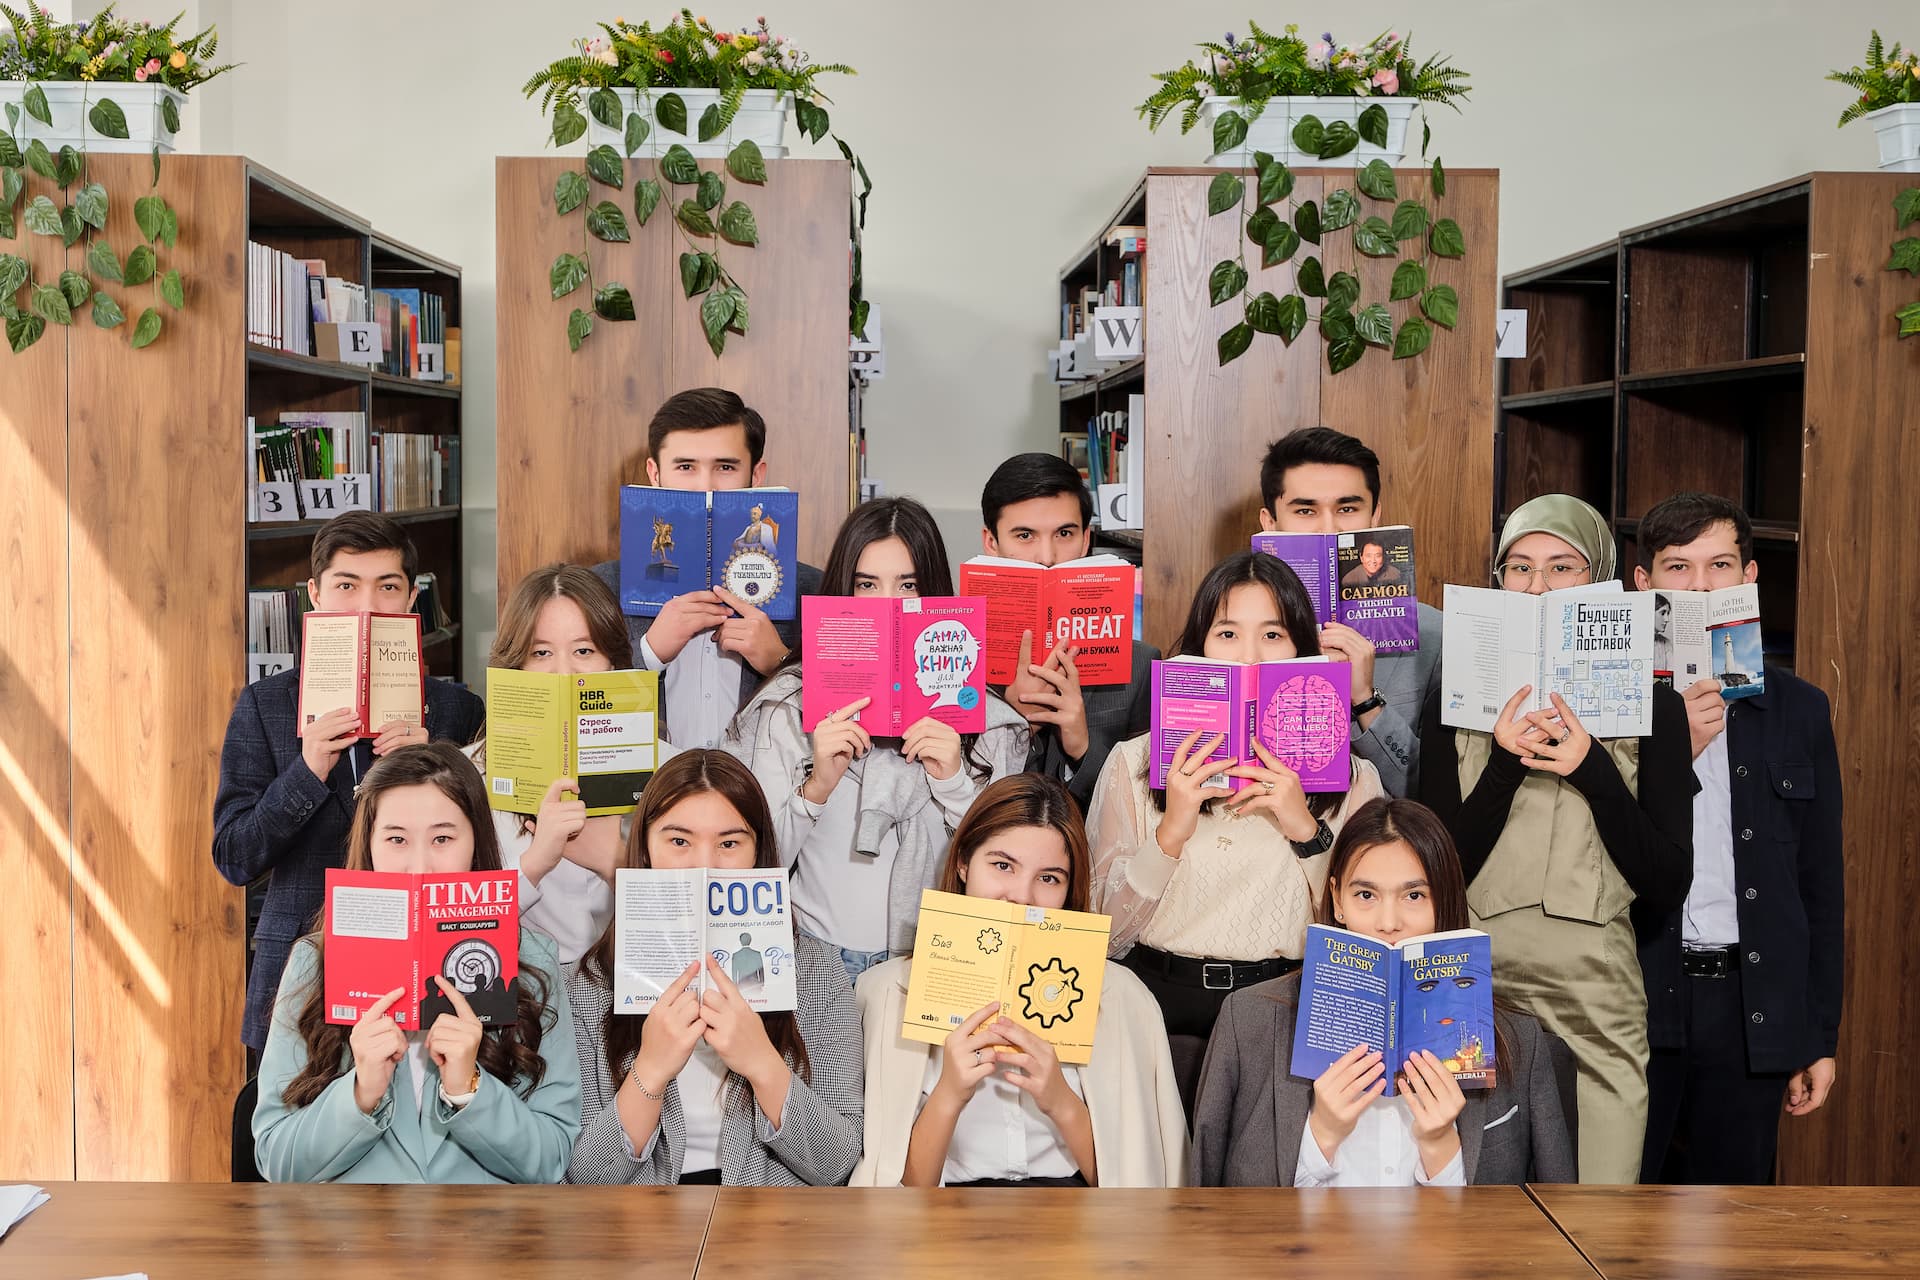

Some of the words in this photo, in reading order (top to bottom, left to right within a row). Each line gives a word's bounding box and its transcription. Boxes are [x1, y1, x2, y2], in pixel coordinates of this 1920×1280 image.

[350, 329, 371, 352] Е
[1098, 318, 1141, 349] W
[310, 487, 336, 509] И
[343, 476, 360, 505] Й
[263, 490, 282, 513] З
[1341, 584, 1409, 600] САРМОЯ
[1357, 599, 1393, 607] ТИКИШ
[1721, 599, 1730, 607] TO
[1732, 597, 1745, 606] THE
[1070, 607, 1097, 615] GOOD
[1099, 606, 1112, 614] TO
[1346, 607, 1406, 620] САНЪАТИ
[1056, 614, 1125, 640] GREAT
[393, 639, 407, 647] with
[924, 629, 967, 643] САМАЯ
[930, 644, 963, 653] ВАЖНАЯ
[1576, 637, 1632, 651] ПОСТАВОК
[379, 647, 418, 662] Morrie
[920, 655, 972, 673] КНИГА
[579, 690, 605, 701] HBR
[579, 701, 613, 711] Guide
[579, 718, 612, 727] Стресс
[1283, 715, 1303, 723] САМ
[1305, 715, 1328, 723] СЕБЕ
[592, 726, 624, 736] работе
[1283, 724, 1329, 732] ПЛАЦЕБО
[422, 880, 513, 907] TIME
[708, 880, 784, 917] СОС!
[428, 904, 512, 919] MANAGEMENT
[1039, 916, 1062, 931] Биз
[931, 933, 953, 949] Биз
[1324, 937, 1347, 953] THE
[1348, 943, 1382, 962] GREAT
[1329, 950, 1376, 973] GATSBY
[1408, 957, 1430, 969] THE
[1431, 953, 1470, 966] GREAT
[1414, 965, 1463, 981] GATSBY
[634, 993, 659, 1002] asaxiy
[1454, 1072, 1487, 1081] ZGERALD
